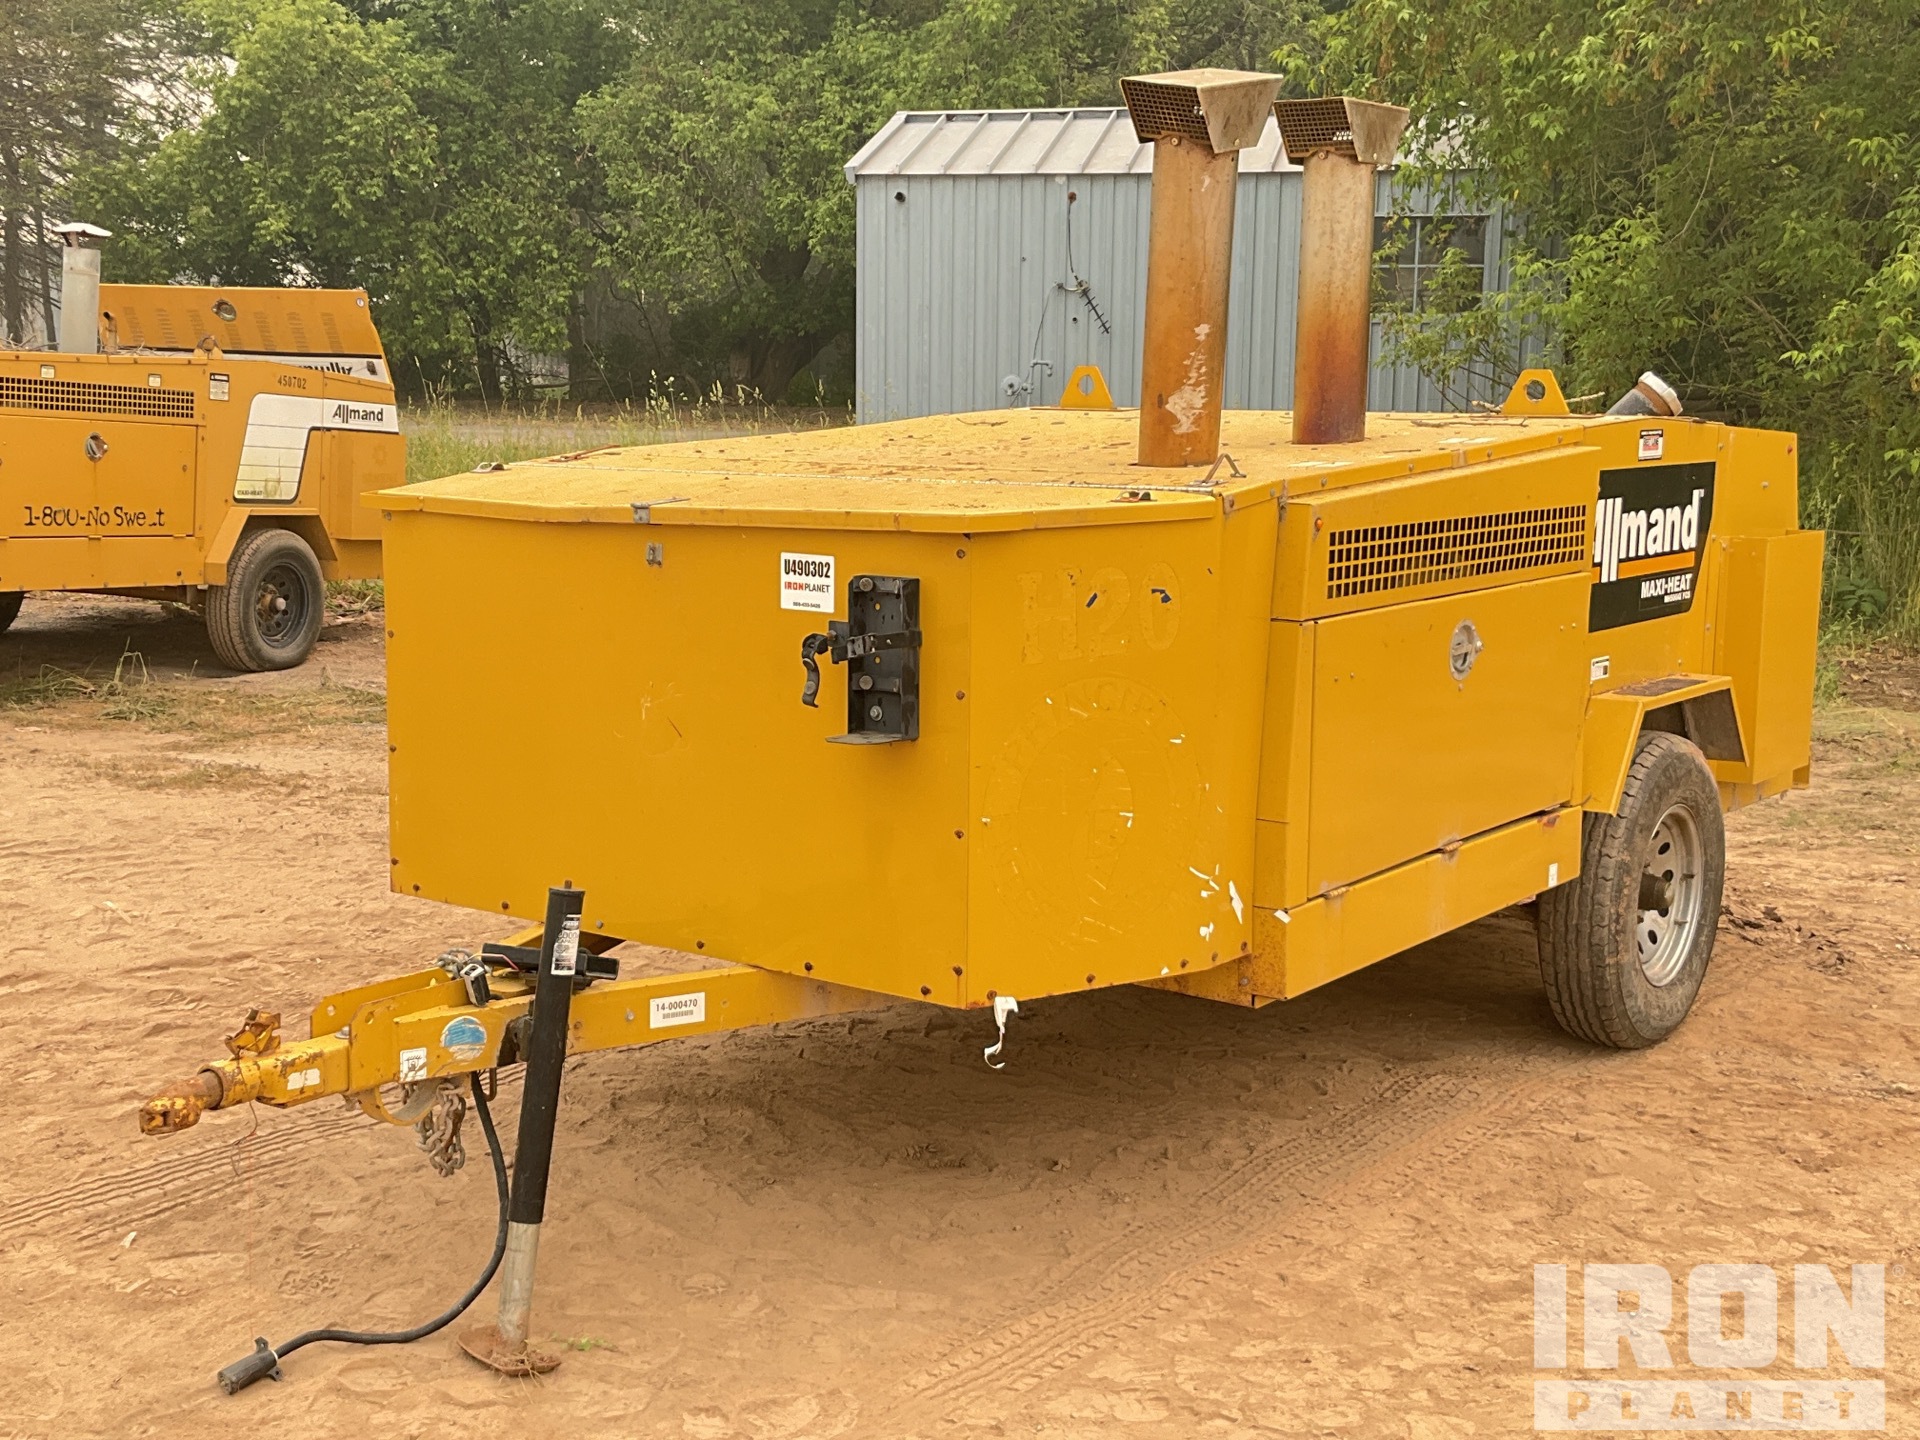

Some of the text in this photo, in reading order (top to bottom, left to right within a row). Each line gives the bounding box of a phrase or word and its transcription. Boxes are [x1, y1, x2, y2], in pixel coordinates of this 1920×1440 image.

[332, 404, 384, 424] Allmand
[113, 506, 165, 527] Swet
[784, 558, 831, 579] U490302
[1640, 572, 1693, 599] MAXI-HEAT
[656, 998, 698, 1012] 14-000470
